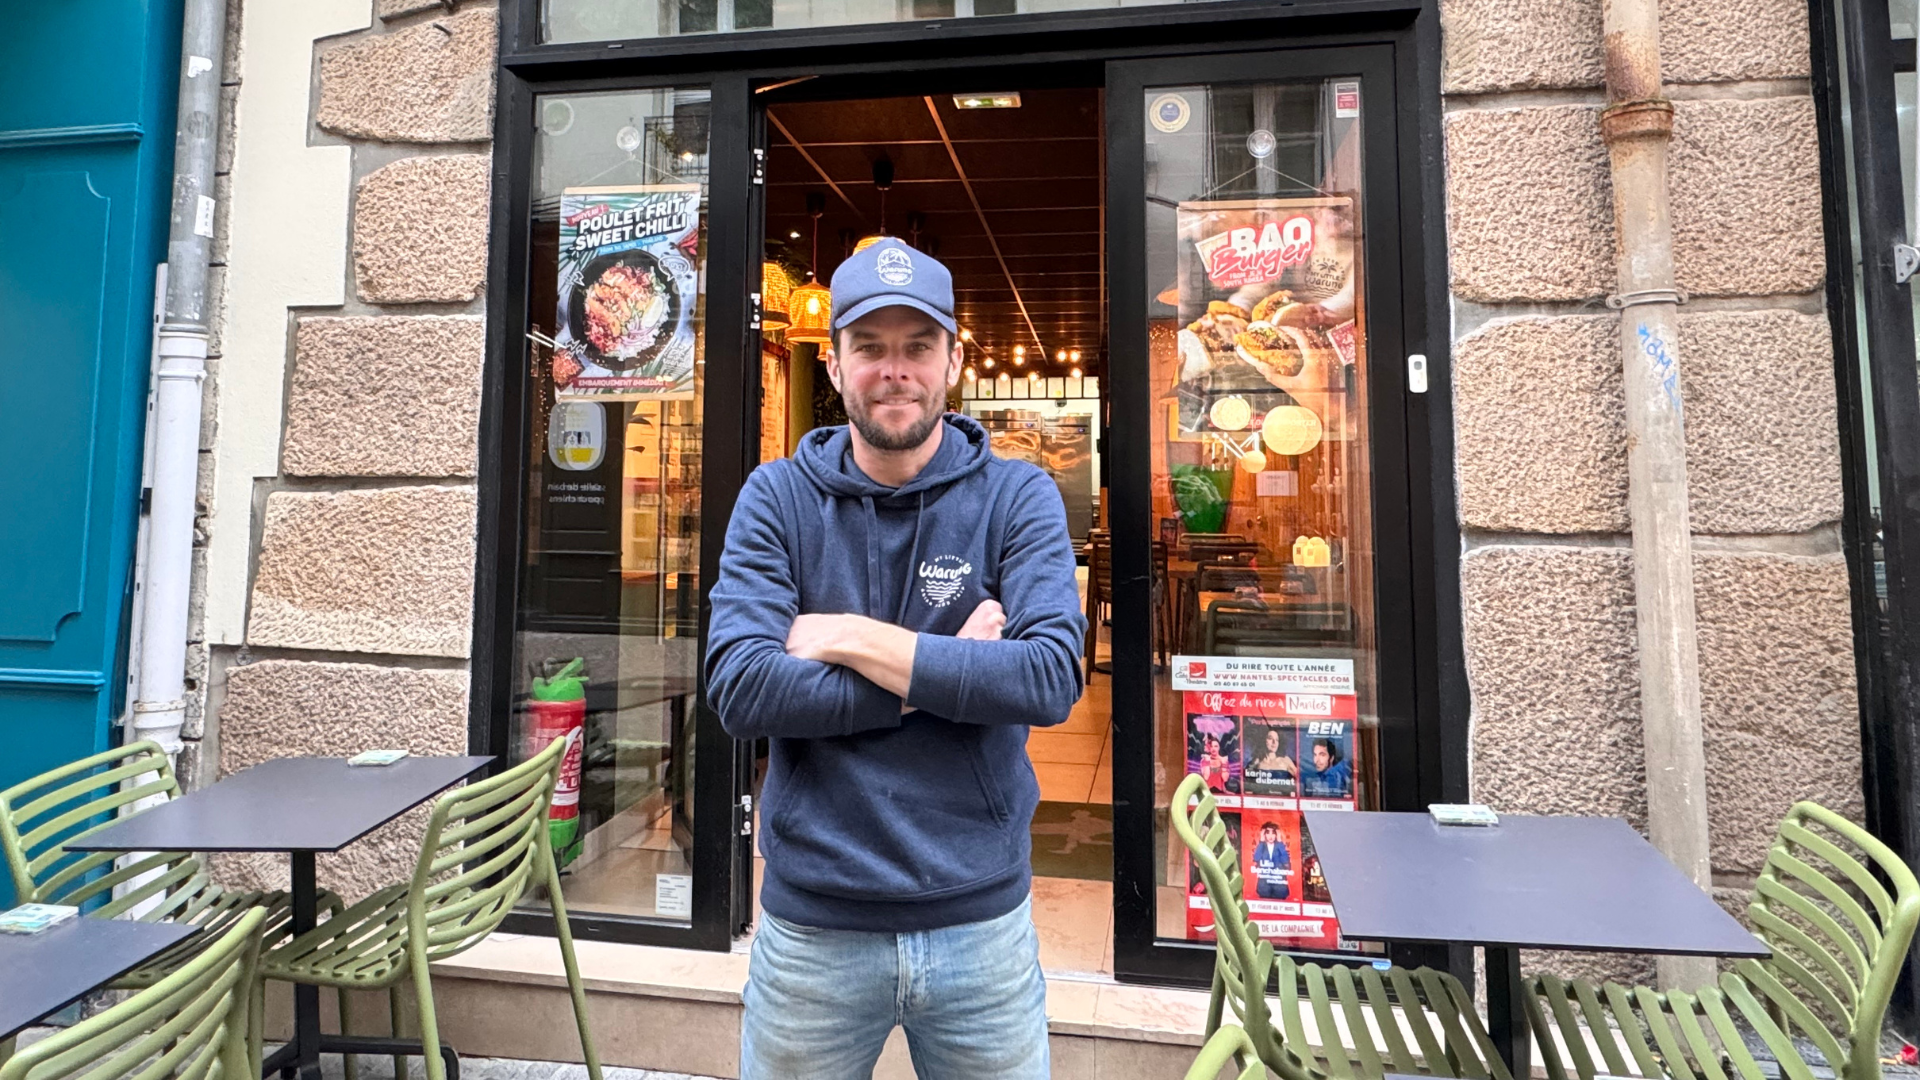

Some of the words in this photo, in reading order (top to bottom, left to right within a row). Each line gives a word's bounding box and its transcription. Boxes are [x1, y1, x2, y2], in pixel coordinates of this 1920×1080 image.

[579, 206, 644, 234] POULET
[575, 225, 634, 251] SWEET
[634, 212, 688, 238] CHILLI
[1231, 217, 1312, 256] BAO
[1212, 240, 1312, 278] Burger
[578, 379, 632, 387] EMBARQUEMENT
[1226, 662, 1239, 670] DU
[1264, 663, 1295, 671] TOUTE
[1297, 664, 1336, 672] L'ANNÉE
[1213, 673, 1350, 683] WWW.NANTES-SPECTACLES.COM
[1203, 693, 1236, 712] Offrez
[1240, 694, 1253, 708] du
[1255, 696, 1277, 708] rire
[1289, 696, 1327, 711] Nantes
[1307, 721, 1344, 735] BEN
[1245, 769, 1272, 778] karine
[1261, 924, 1269, 933] DE
[1271, 924, 1279, 933] LA
[1280, 924, 1315, 934] COMPAGNIE
